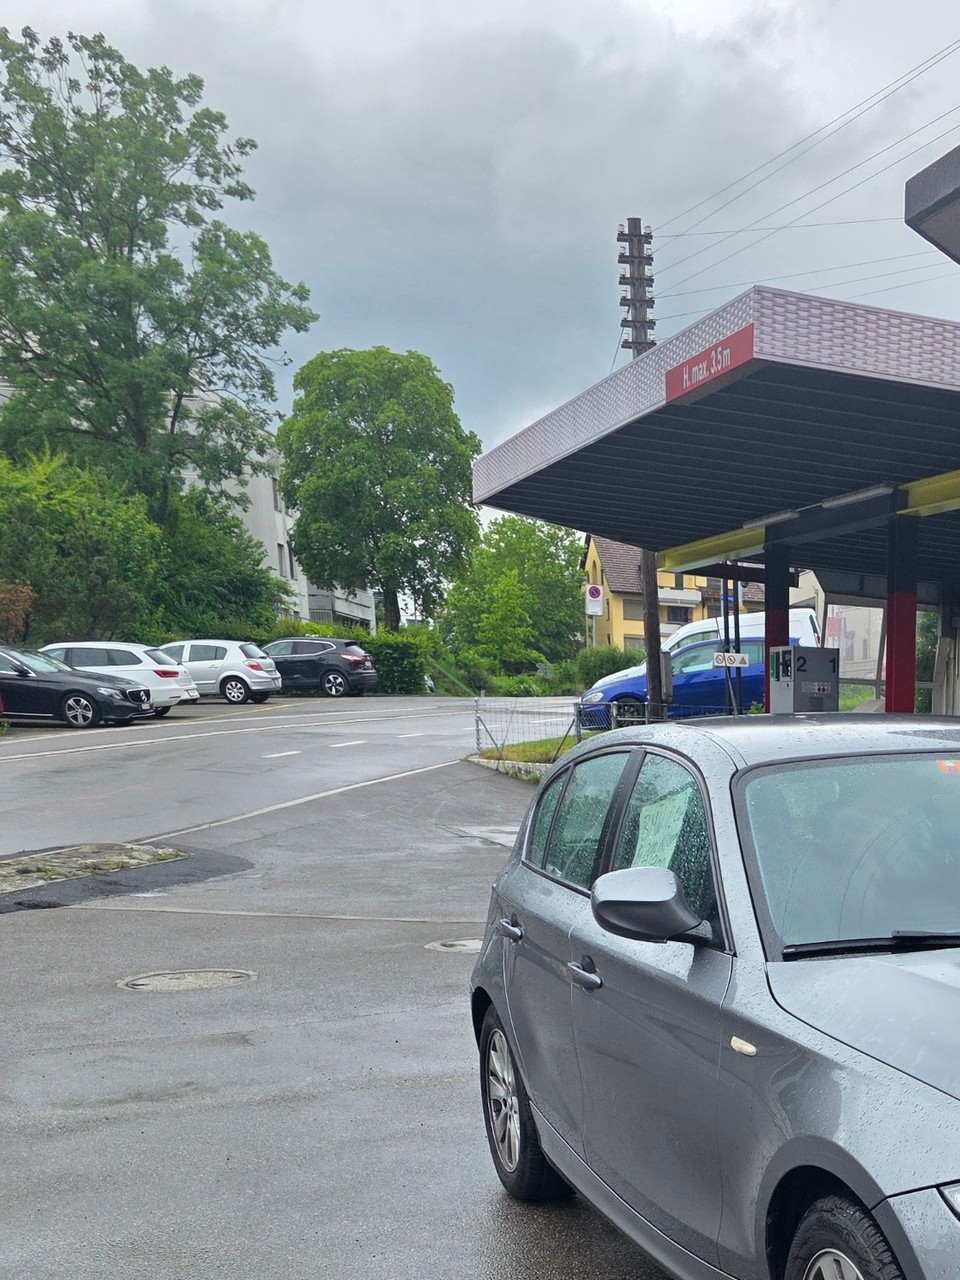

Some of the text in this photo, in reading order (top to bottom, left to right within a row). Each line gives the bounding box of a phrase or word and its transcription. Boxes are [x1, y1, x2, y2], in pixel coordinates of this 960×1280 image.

[683, 365, 691, 389] H.
[692, 361, 709, 384] max.
[796, 656, 807, 673] 2
[829, 657, 836, 674] 1
